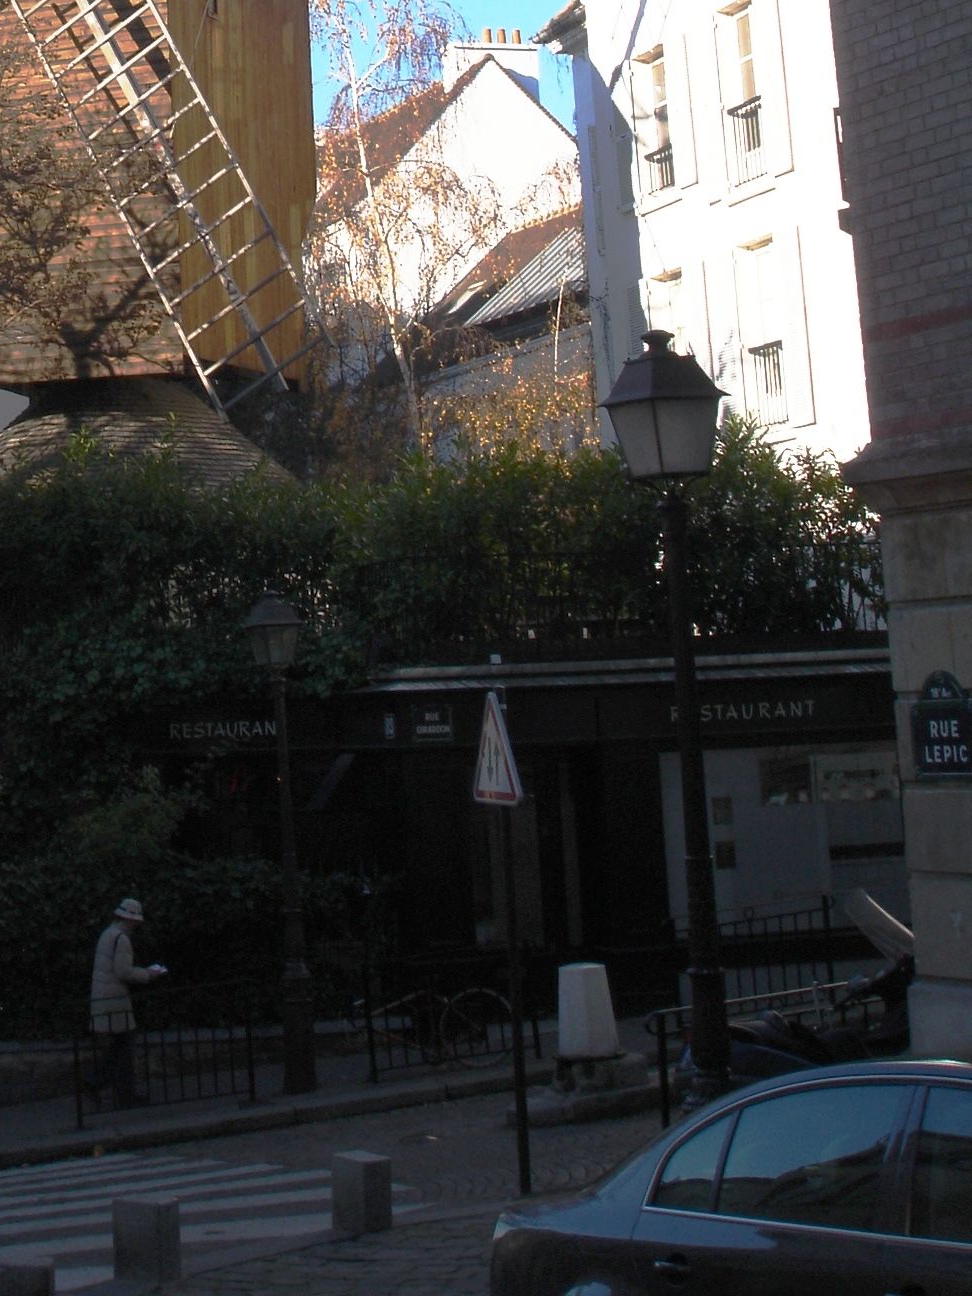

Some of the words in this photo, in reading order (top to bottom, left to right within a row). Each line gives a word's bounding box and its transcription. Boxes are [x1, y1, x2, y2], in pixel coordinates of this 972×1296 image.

[669, 700, 815, 722] RSTAURANT
[169, 720, 279, 739] RESTAURAN
[929, 719, 960, 737] RUE
[924, 745, 968, 763] LEPIC
